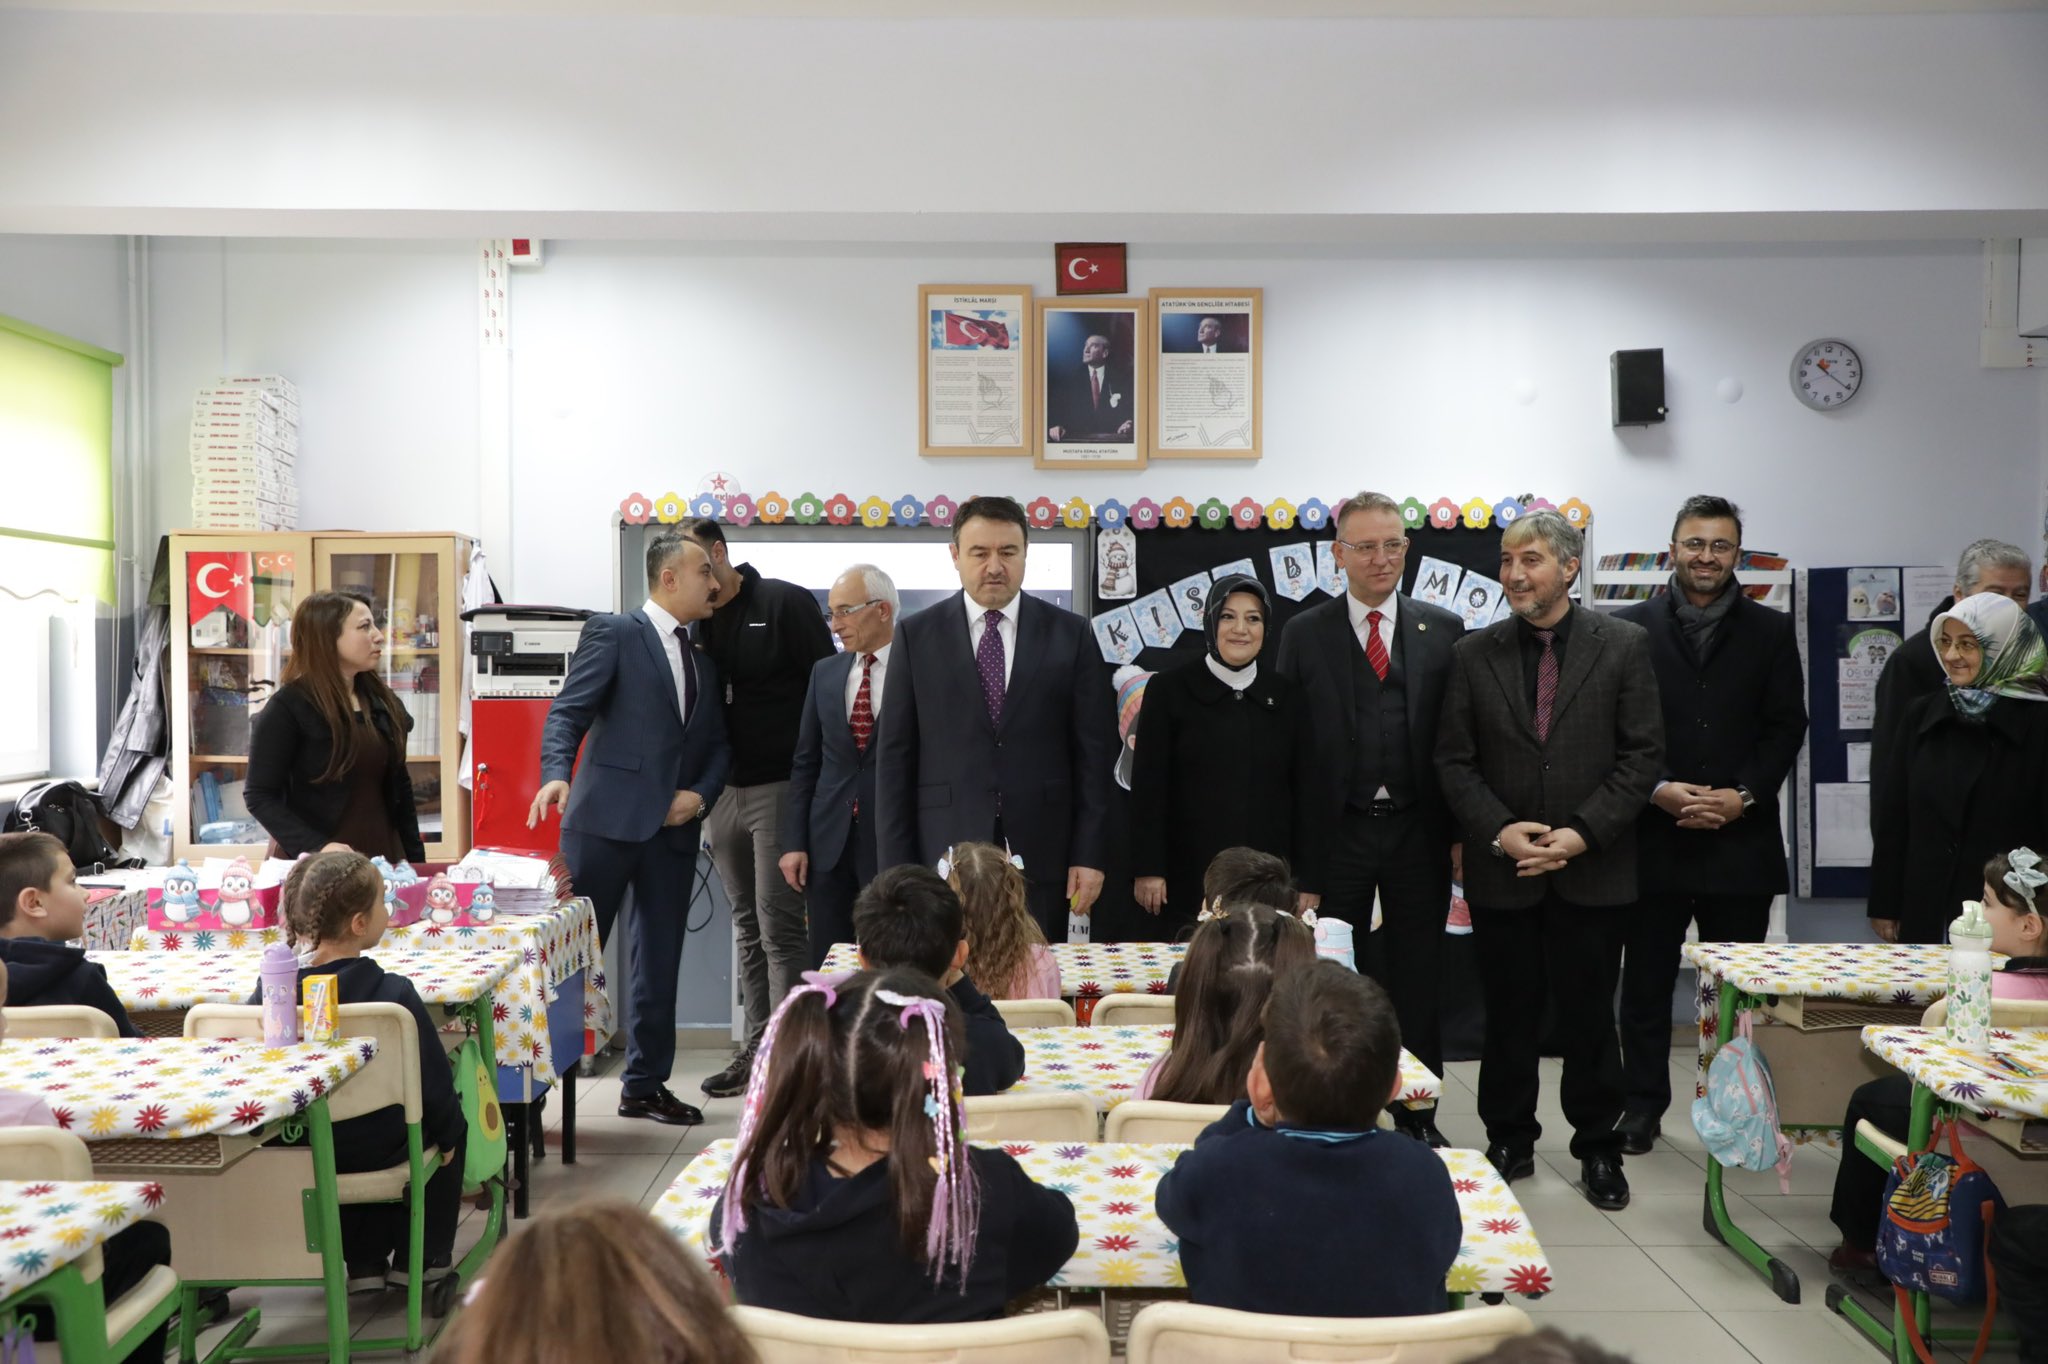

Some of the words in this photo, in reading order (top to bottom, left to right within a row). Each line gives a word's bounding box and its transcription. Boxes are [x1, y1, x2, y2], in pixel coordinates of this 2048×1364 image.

[1849, 370, 1856, 378] 3
[1813, 391, 1818, 399] 7
[1836, 391, 1843, 399] 5
[632, 504, 640, 513] A
[667, 504, 674, 513] B
[701, 505, 709, 514] C
[735, 505, 744, 515] Ç
[769, 504, 777, 513] D
[804, 505, 811, 514] E
[837, 506, 843, 515] F
[870, 508, 879, 517] G
[937, 507, 945, 516] H
[1039, 509, 1045, 517] J
[1073, 510, 1080, 518] K
[1109, 511, 1115, 519] L
[1140, 510, 1150, 518] M
[1174, 509, 1182, 518] N
[1209, 509, 1218, 518] O
[1243, 508, 1252, 519] Ö
[1278, 510, 1284, 519] P
[1311, 510, 1317, 519] R
[1408, 509, 1414, 518] T
[1440, 510, 1448, 518] U
[1505, 509, 1513, 518] V
[1571, 509, 1578, 519] Z
